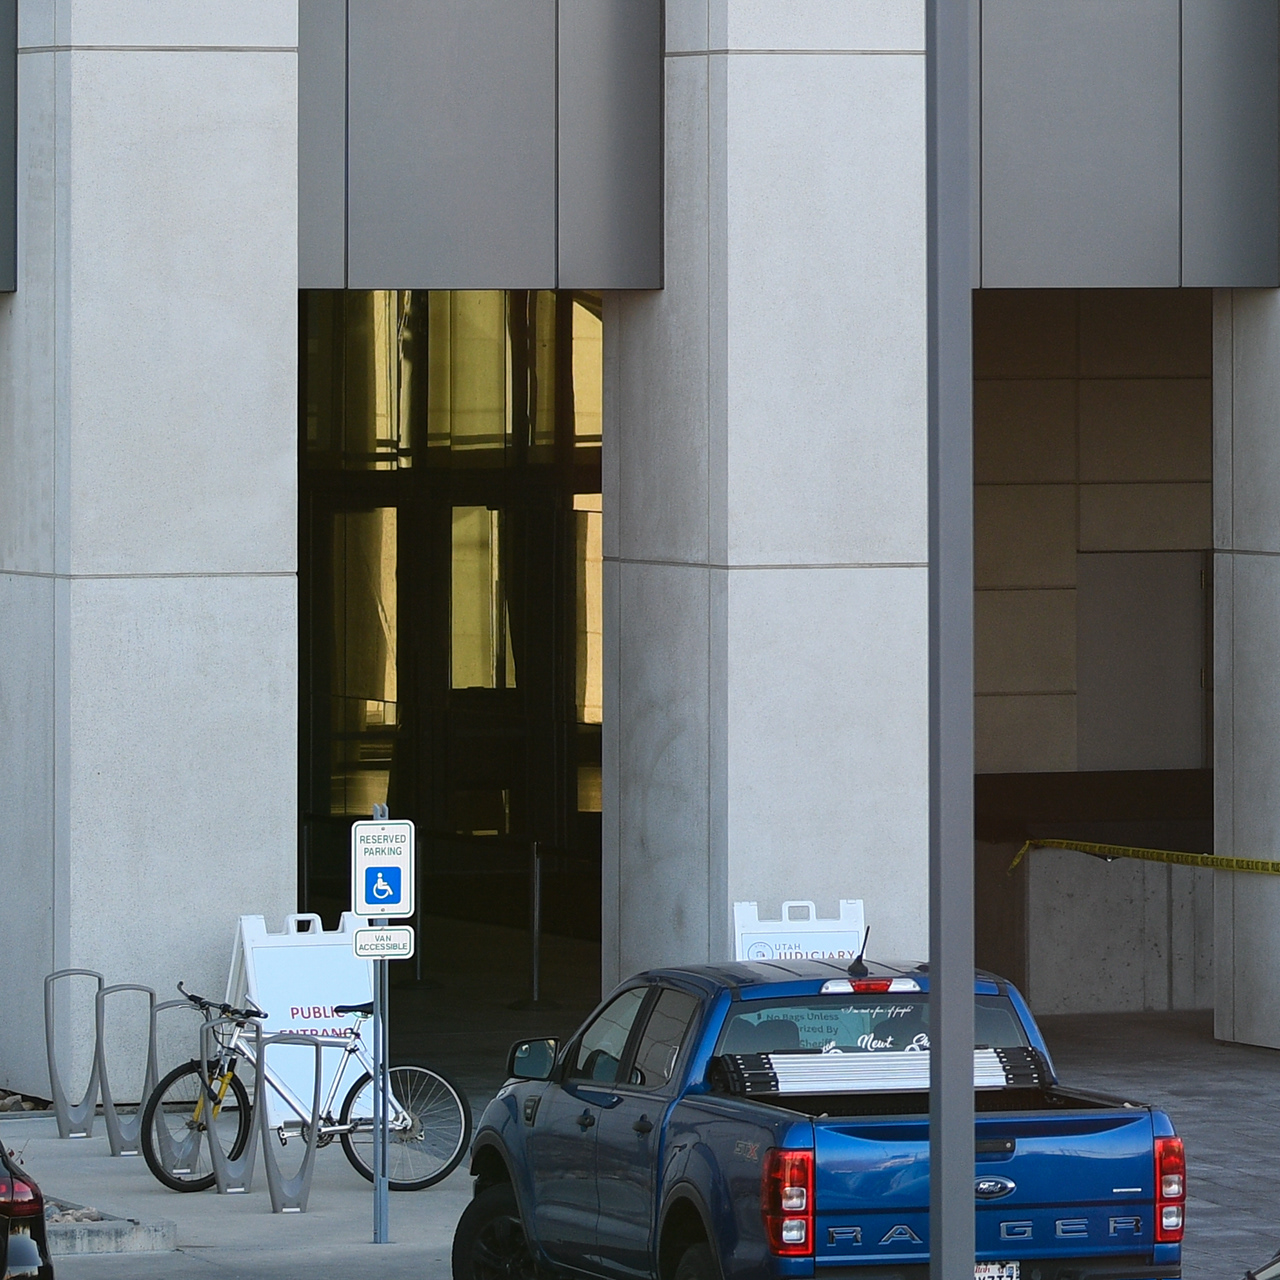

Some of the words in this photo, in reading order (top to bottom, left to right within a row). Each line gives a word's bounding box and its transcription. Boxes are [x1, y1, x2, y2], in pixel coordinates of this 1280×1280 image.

[359, 834, 407, 844] RESERVED
[363, 846, 403, 857] PARKING
[358, 943, 408, 951] ACCESSIBLE
[778, 950, 855, 960] JUDICIARY
[806, 1013, 840, 1021] Unless
[826, 1026, 839, 1035] By
[826, 1216, 1143, 1247] RAGER
